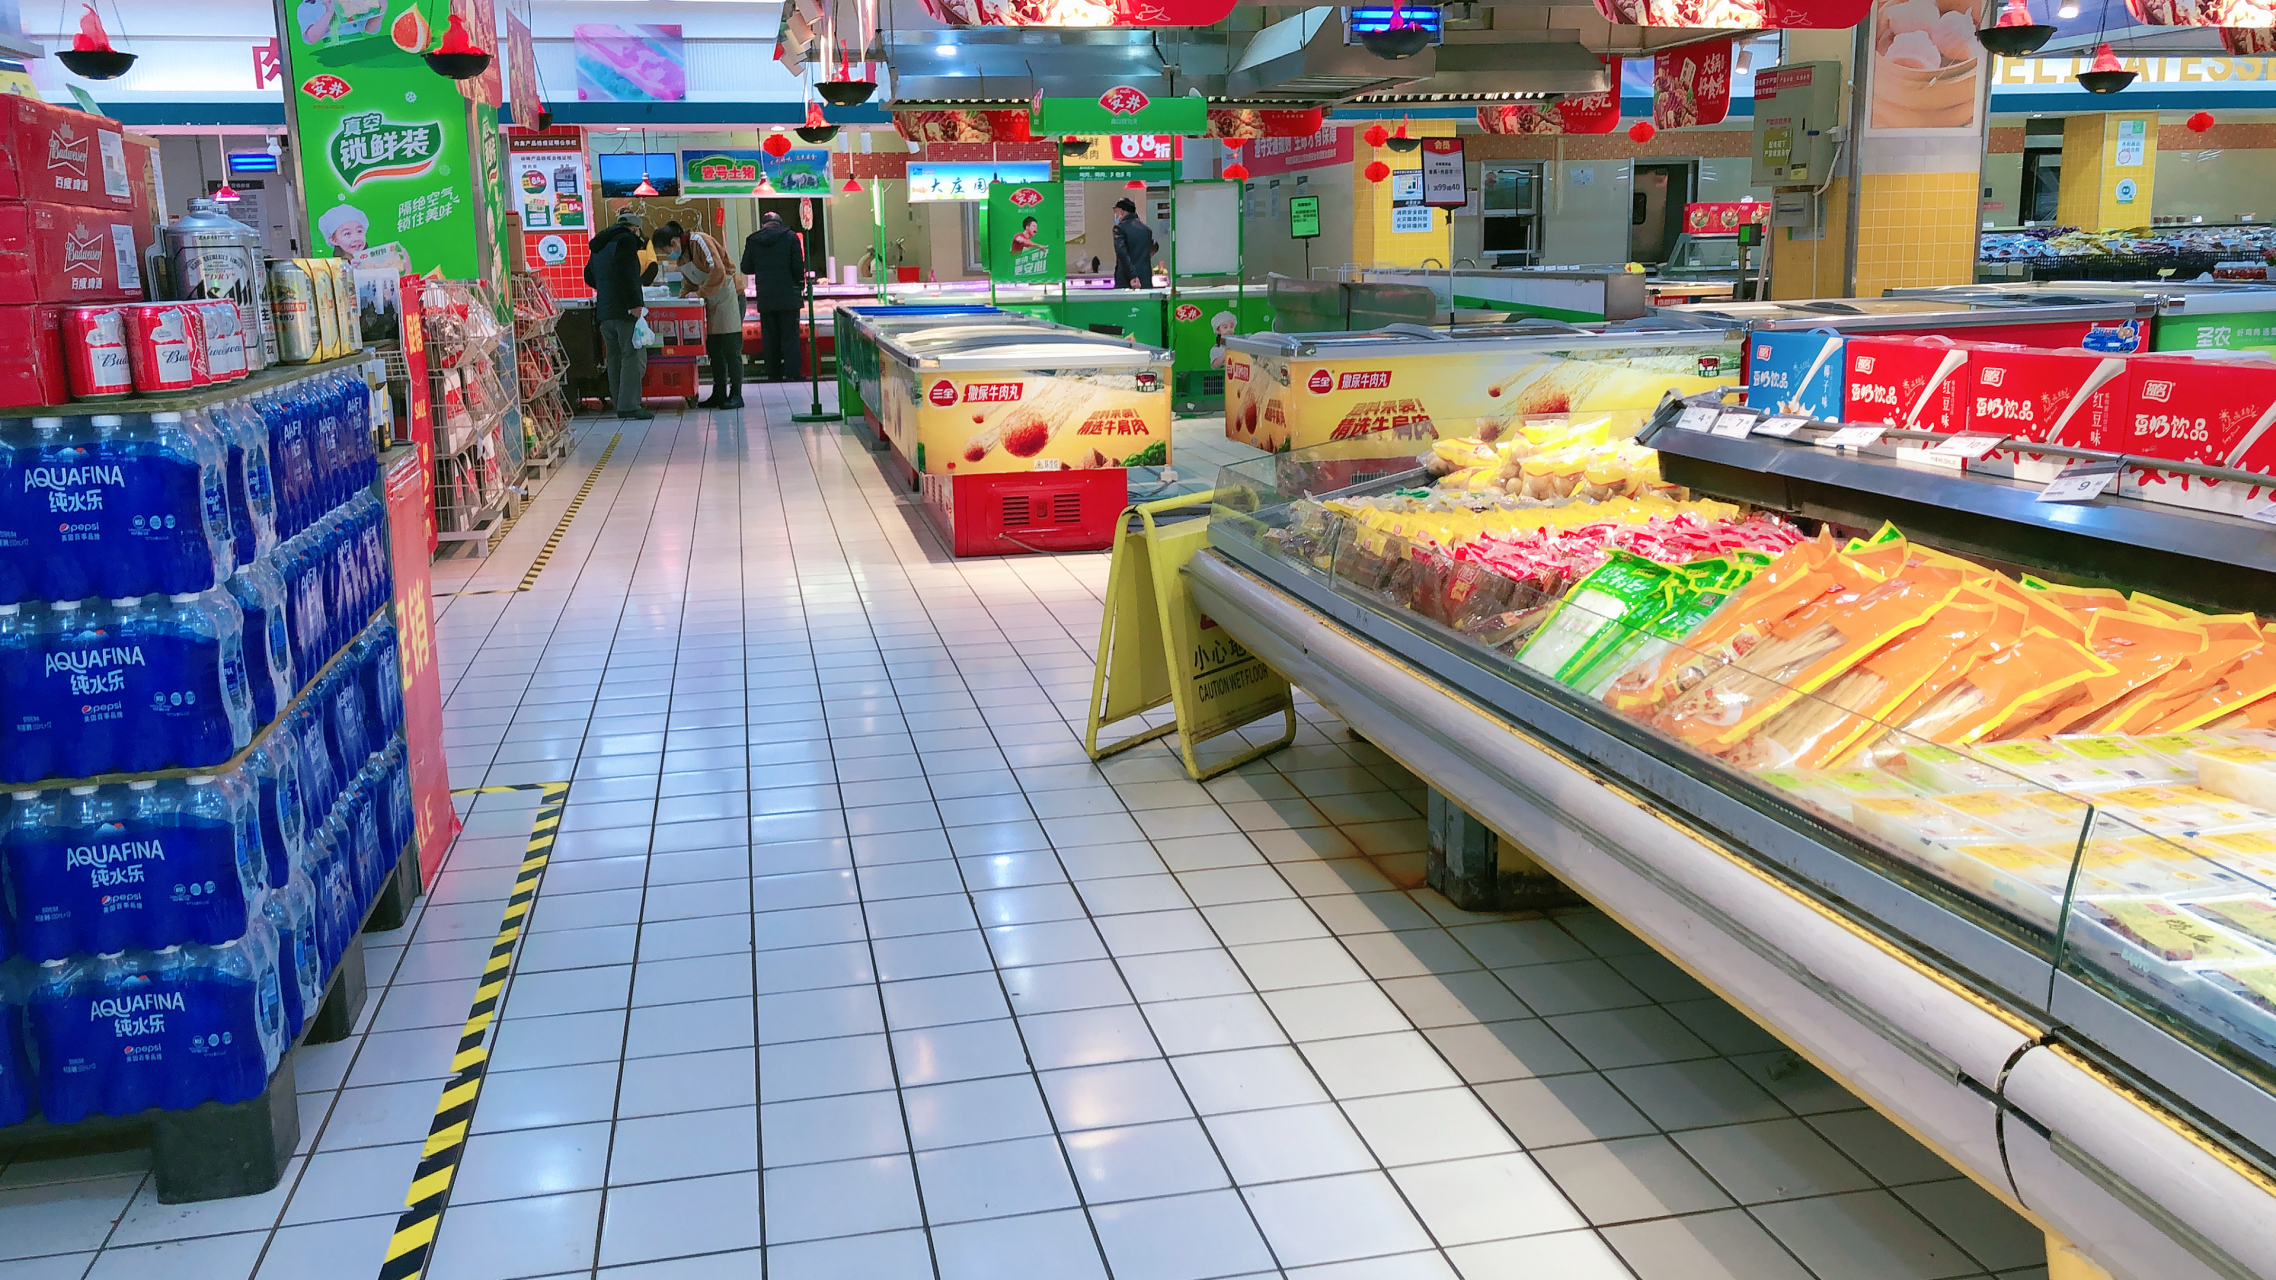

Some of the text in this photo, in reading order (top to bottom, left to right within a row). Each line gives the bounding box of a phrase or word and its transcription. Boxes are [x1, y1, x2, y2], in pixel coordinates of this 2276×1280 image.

[311, 82, 343, 96] 安井
[1108, 94, 1140, 110] 安井
[344, 114, 381, 135] 真空
[49, 138, 87, 163] Budweiser
[340, 128, 430, 171] 锁鲜装
[702, 165, 755, 180] 壹号土猪
[55, 176, 88, 192] 百威啤酒
[398, 187, 454, 218] 隔绝空气
[1016, 194, 1038, 204] 安井
[397, 202, 453, 232] 锁住美味
[65, 240, 102, 263] Budweiser
[71, 277, 103, 291] 百威啤酒
[2196, 326, 2231, 347] 圣农
[1310, 377, 1331, 388] 三全
[1342, 372, 1389, 389] 撒尿牛肉丸
[1753, 371, 1788, 388] 豆奶饮品
[1821, 364, 1831, 408] 椰子味
[932, 388, 955, 399] 三全
[967, 383, 1020, 400] 撒尿牛肉丸
[1851, 383, 1898, 405] 豆奶饮品
[414, 399, 427, 420] SALE
[1941, 379, 1951, 428] 红豆味
[1976, 397, 2034, 421] 豆奶饮品
[1077, 419, 1149, 435] 精选牛肩肉
[1330, 412, 1439, 441] 精选牛肩肉
[2090, 391, 2104, 446] 红豆味
[2134, 414, 2209, 441] 豆奶饮品
[24, 465, 125, 492] AQUAFINA
[2077, 481, 2091, 491] 9
[50, 489, 103, 513] 纯水乐
[70, 522, 99, 533] pepsi
[45, 646, 146, 678] AQUAFINA
[71, 669, 125, 695] 纯水乐
[1199, 663, 1269, 702] CAUTION WET FLOOR
[93, 701, 122, 713] pepsi
[416, 793, 434, 851] LE
[66, 839, 165, 872] AQUAFINA
[91, 864, 145, 888] 纯水乐
[112, 892, 142, 903] pepsi
[90, 992, 186, 1022] AQUAFINA
[115, 1013, 165, 1038] 纯水乐
[135, 1043, 162, 1054] pepsi
